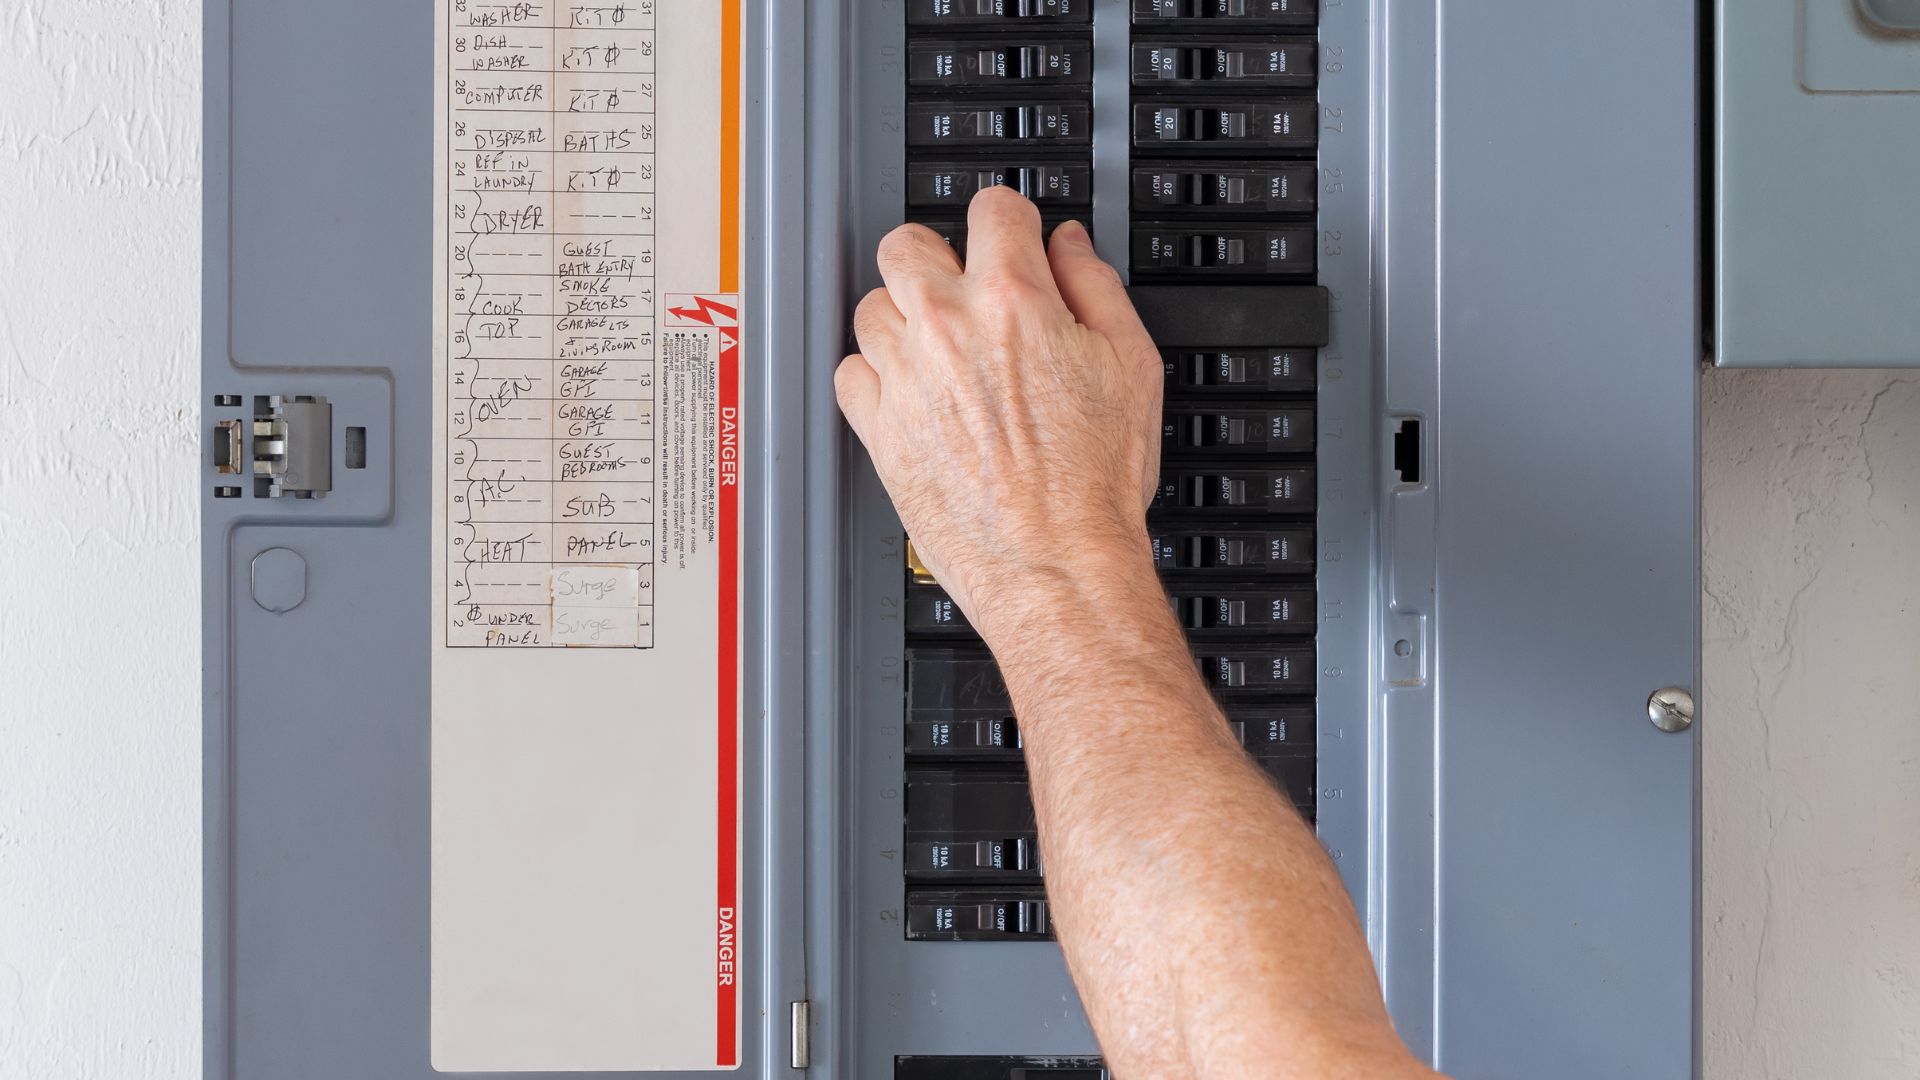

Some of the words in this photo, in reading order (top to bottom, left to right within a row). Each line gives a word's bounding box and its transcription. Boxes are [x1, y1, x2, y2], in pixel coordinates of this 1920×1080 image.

[469, 3, 539, 27] WASHER
[641, 2, 652, 16] 31
[455, 37, 465, 52] 30
[641, 41, 652, 56] 29
[473, 57, 530, 70] WASHER
[944, 55, 952, 65] 10
[1050, 55, 1058, 68] 20
[1164, 57, 1172, 70] 20
[1270, 62, 1278, 72] 10
[455, 79, 465, 95] 28
[465, 84, 542, 104] COMPUTER
[641, 83, 652, 98] 27
[942, 116, 950, 126] 10
[1048, 115, 1056, 128] 20
[1165, 117, 1174, 130] 20
[455, 122, 465, 137] 26
[641, 125, 652, 140] 25
[1273, 123, 1281, 134] 10
[564, 129, 631, 152] BATHS
[455, 161, 465, 177] 24
[641, 164, 652, 180] 23
[474, 172, 536, 195] LAUNDRY
[943, 175, 951, 185] 10
[1050, 176, 1058, 189] 20
[1164, 182, 1172, 195] 20
[1272, 187, 1279, 198] 10
[455, 204, 465, 219] 22
[641, 207, 652, 220] 21
[483, 205, 544, 235] DRYER
[455, 245, 465, 261] 20
[563, 240, 612, 256] GUEST
[1164, 244, 1172, 257] 20
[1271, 249, 1278, 259] 10
[641, 249, 652, 264] 19
[559, 263, 590, 278] BATH
[560, 278, 611, 294] SMOKE
[455, 288, 465, 301] 18
[641, 290, 652, 304] 17
[483, 296, 524, 316] COOK
[480, 318, 519, 341] TOP
[557, 316, 607, 331] GARAGE
[455, 330, 465, 344] 16
[641, 333, 652, 346] 15
[560, 362, 608, 378] GARAGE
[1273, 366, 1281, 376] 10
[455, 372, 465, 385] 14
[640, 372, 651, 387] 13
[478, 374, 532, 423] OVEN
[708, 392, 715, 402] OF
[455, 411, 465, 425] 12
[558, 404, 613, 420] GARAGE
[640, 412, 650, 426] 11
[559, 442, 615, 459] GUEST
[721, 407, 736, 486] DANGER
[455, 451, 465, 465] 10
[640, 457, 650, 465] 9
[562, 457, 626, 480] BEDROOMS
[708, 490, 715, 500] OR
[1166, 485, 1175, 496] 15
[454, 494, 464, 503] 8
[562, 493, 615, 517] SUB
[640, 496, 650, 504] 7
[454, 537, 464, 546] 6
[567, 531, 632, 557] PANEL
[640, 539, 650, 547] 5
[480, 533, 533, 569] HEAT
[1164, 546, 1172, 558] 15
[1272, 550, 1279, 560] 10
[454, 580, 464, 588] 4
[558, 571, 617, 600] Surge
[640, 581, 650, 589] 3
[488, 612, 534, 626] UNDER
[1273, 610, 1280, 620] 10
[453, 619, 464, 628] 2
[556, 613, 616, 641] Surge
[485, 630, 540, 646] PANEL
[941, 845, 948, 856] 10
[719, 907, 734, 986] DANGER
